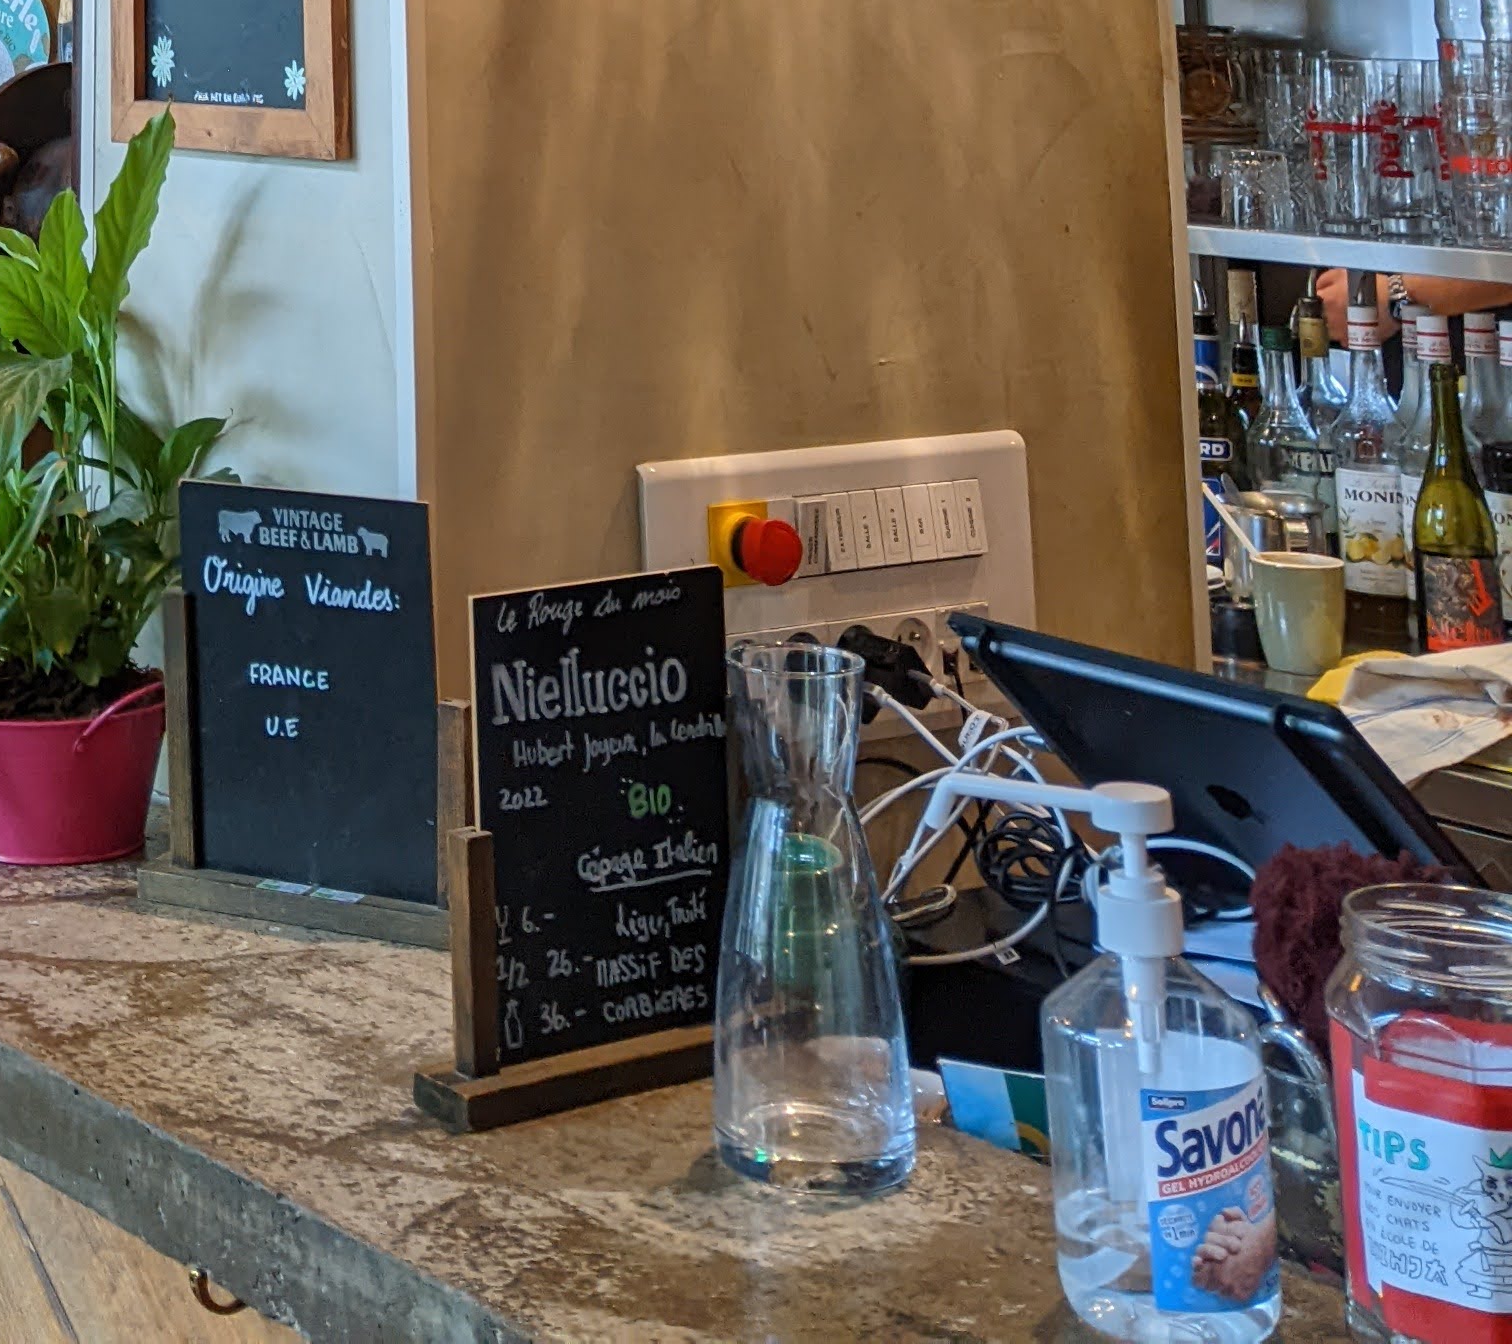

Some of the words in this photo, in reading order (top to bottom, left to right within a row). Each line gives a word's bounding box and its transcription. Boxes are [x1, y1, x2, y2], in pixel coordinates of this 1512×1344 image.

[272, 507, 343, 533] VINTAGE
[259, 527, 299, 551] BEEF
[300, 532, 312, 551] &
[313, 532, 360, 556] LAMB
[203, 555, 286, 616] Origine
[528, 592, 584, 636] Rouge
[593, 588, 623, 617] du
[631, 578, 681, 611] mois
[248, 662, 330, 692] FRANCE
[490, 645, 688, 726] Nielluccio
[498, 785, 549, 811] 2022
[627, 782, 673, 820] BIO
[652, 829, 719, 869] Italien
[668, 943, 707, 974] DES
[1358, 1117, 1431, 1172] TIPS
[1161, 1182, 1187, 1195] GEL
[1386, 1194, 1442, 1218] ENVOYER
[1386, 1213, 1431, 1232] CHATS
[1421, 1238, 1440, 1256] DE
